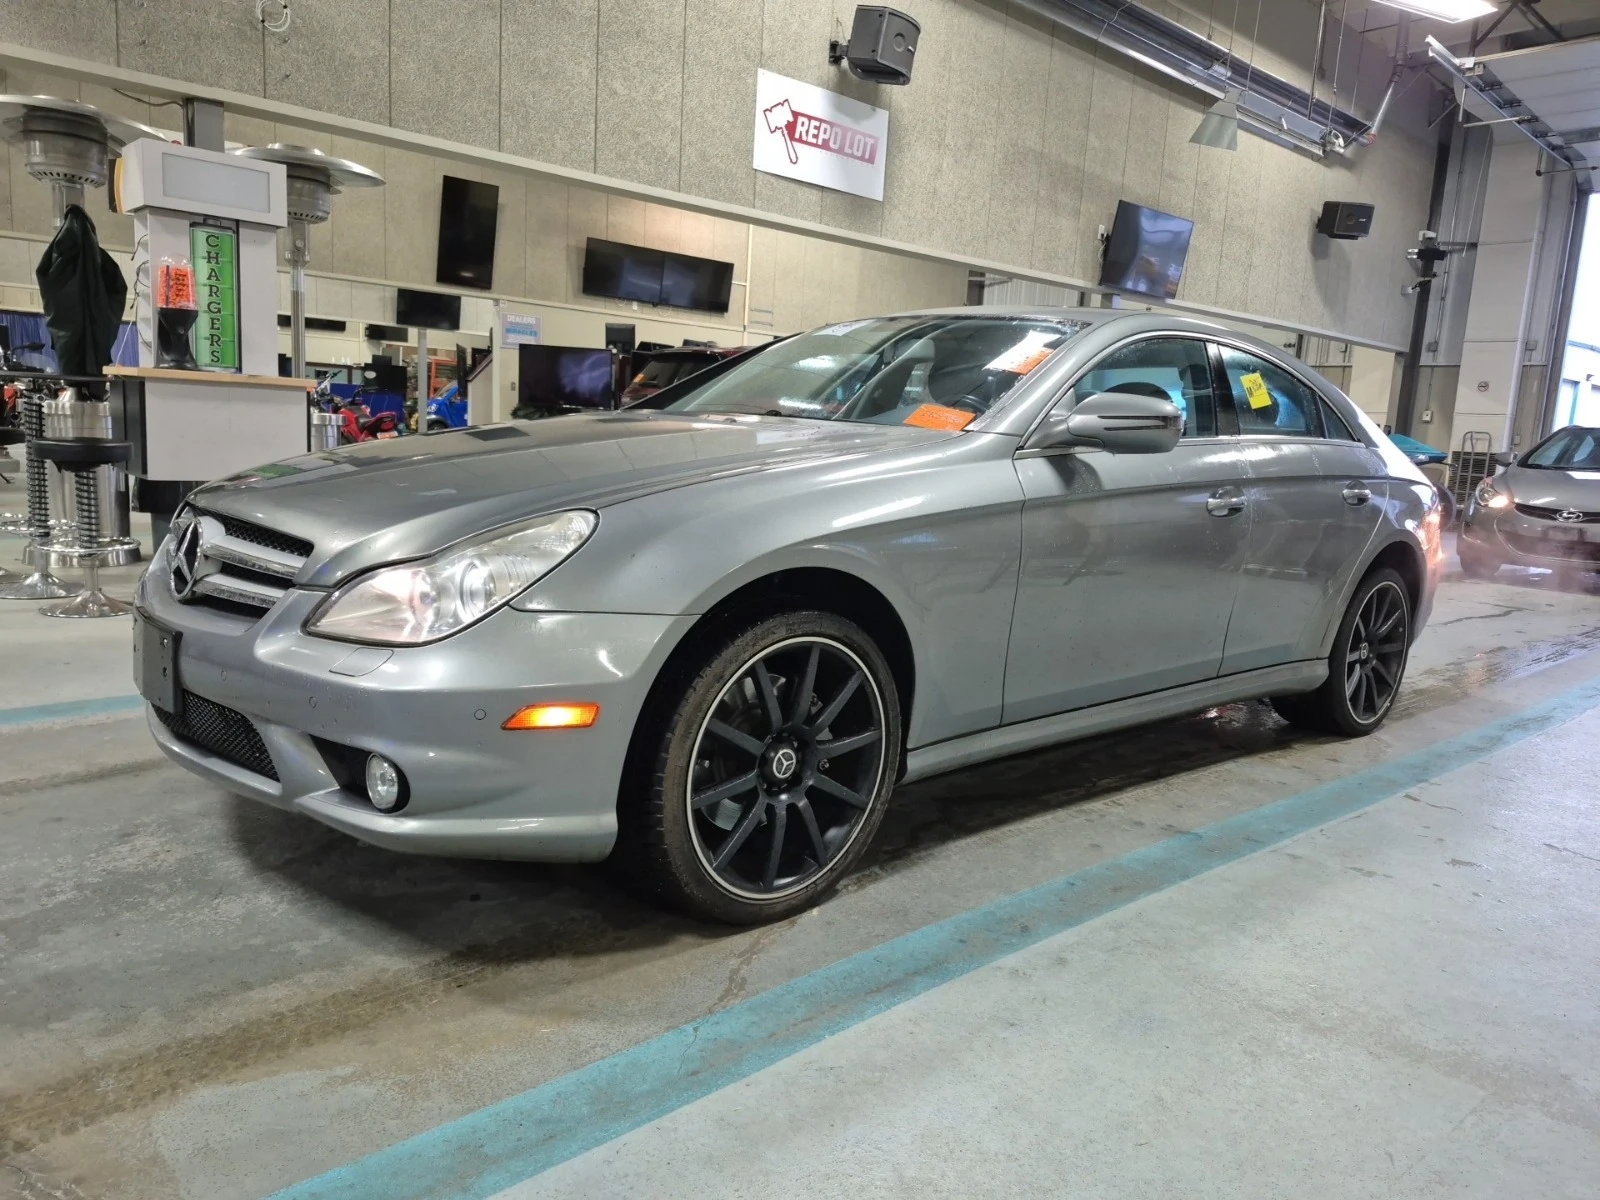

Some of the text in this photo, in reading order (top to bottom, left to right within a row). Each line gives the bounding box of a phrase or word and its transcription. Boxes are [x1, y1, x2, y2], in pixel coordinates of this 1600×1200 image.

[794, 115, 875, 159] REPO LOT
[205, 234, 222, 363] CHARGERS
[507, 315, 536, 325] DEALERS
